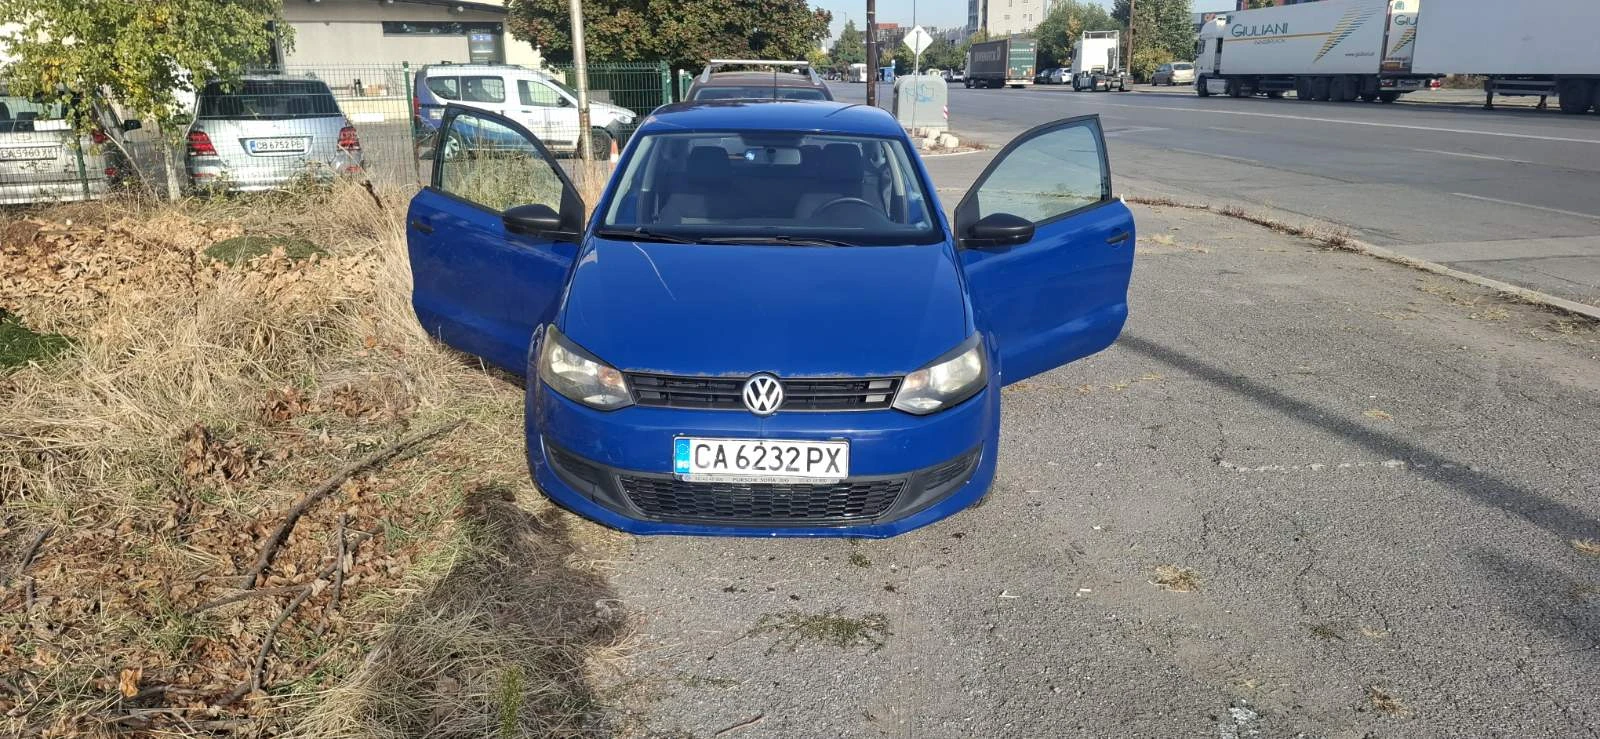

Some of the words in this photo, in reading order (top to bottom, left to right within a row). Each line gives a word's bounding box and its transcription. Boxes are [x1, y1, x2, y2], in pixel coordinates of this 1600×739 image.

[1231, 23, 1289, 38] GIULIANI
[269, 140, 290, 149] 6752
[745, 377, 781, 412] VW
[694, 443, 728, 470] CA
[735, 444, 801, 472] 6232
[806, 447, 842, 474] PX
